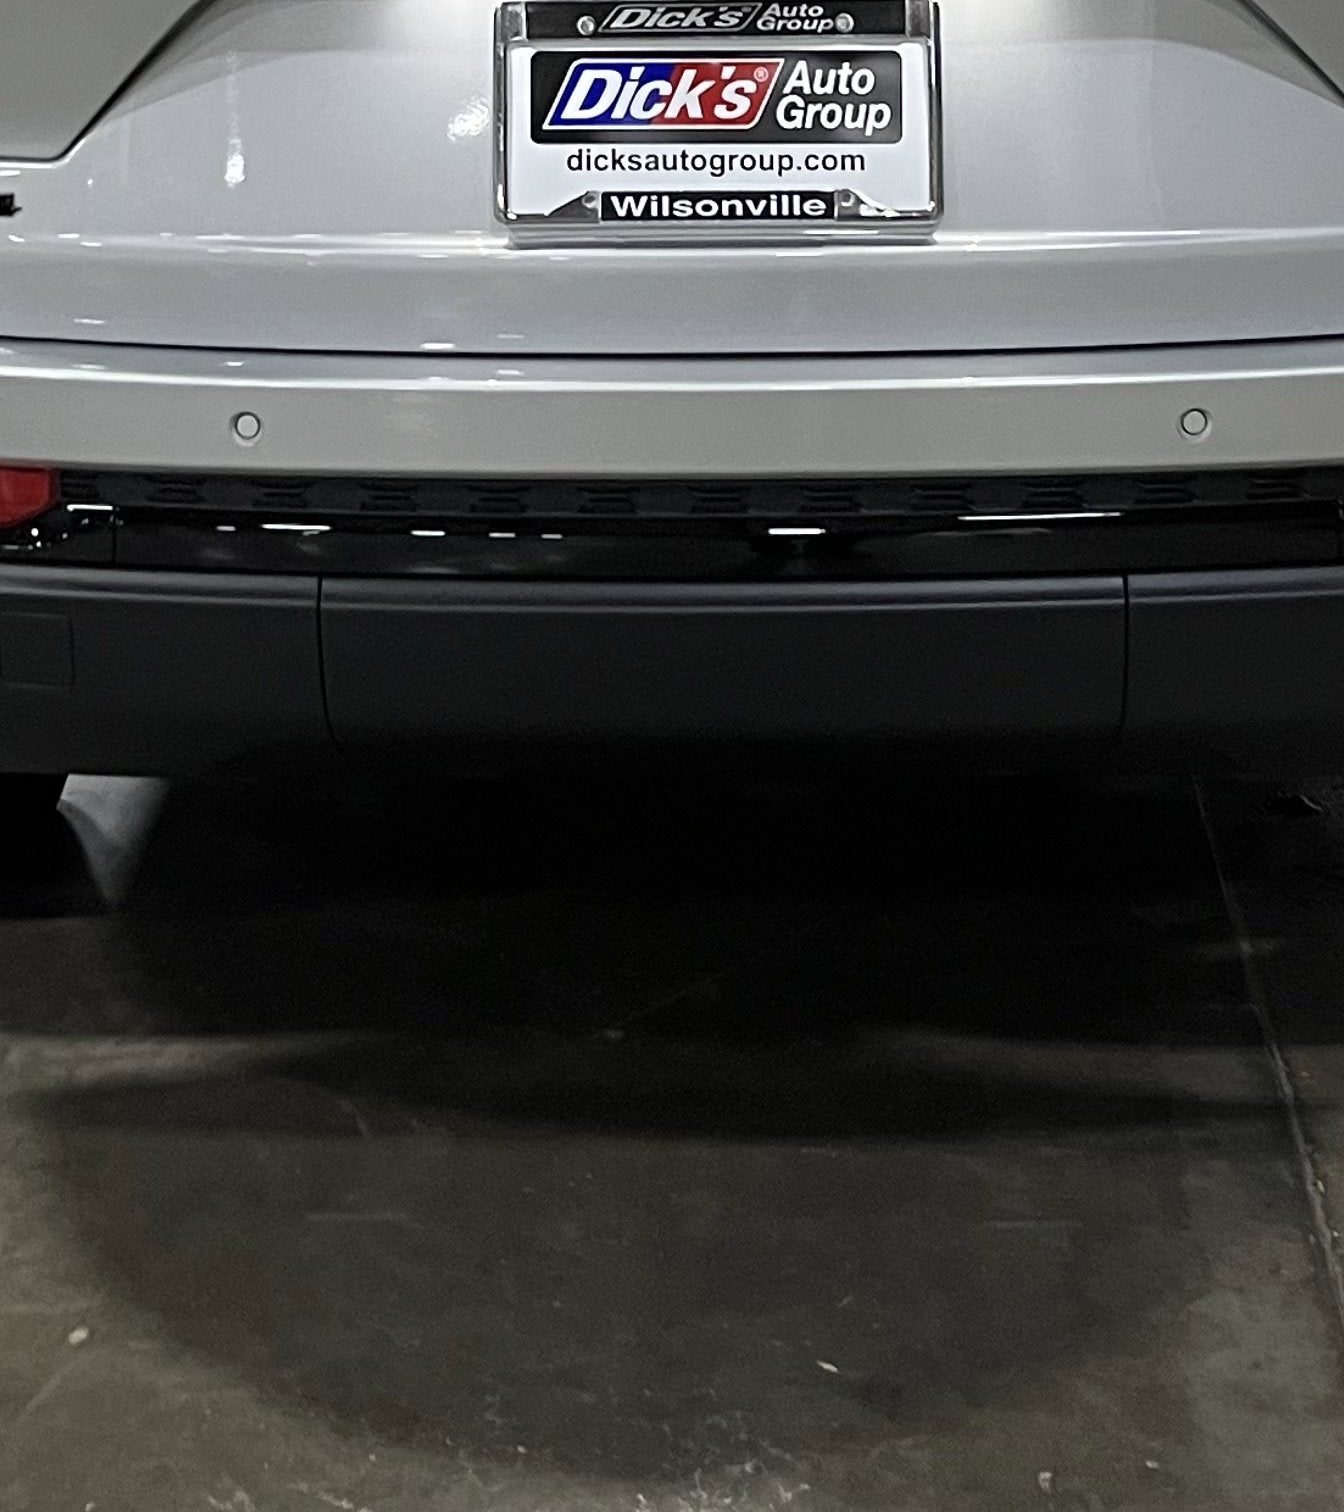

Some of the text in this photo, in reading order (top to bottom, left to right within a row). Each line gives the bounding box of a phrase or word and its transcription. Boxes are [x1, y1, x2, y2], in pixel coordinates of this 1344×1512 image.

[609, 6, 744, 29] Dick's
[761, 3, 824, 17] Auto
[756, 15, 835, 33] Group
[782, 60, 875, 95] Auto
[560, 64, 757, 121] Dick's
[775, 94, 892, 136] Group
[566, 149, 866, 177] dicksautogroup.com
[609, 192, 827, 217] Wilsonville
